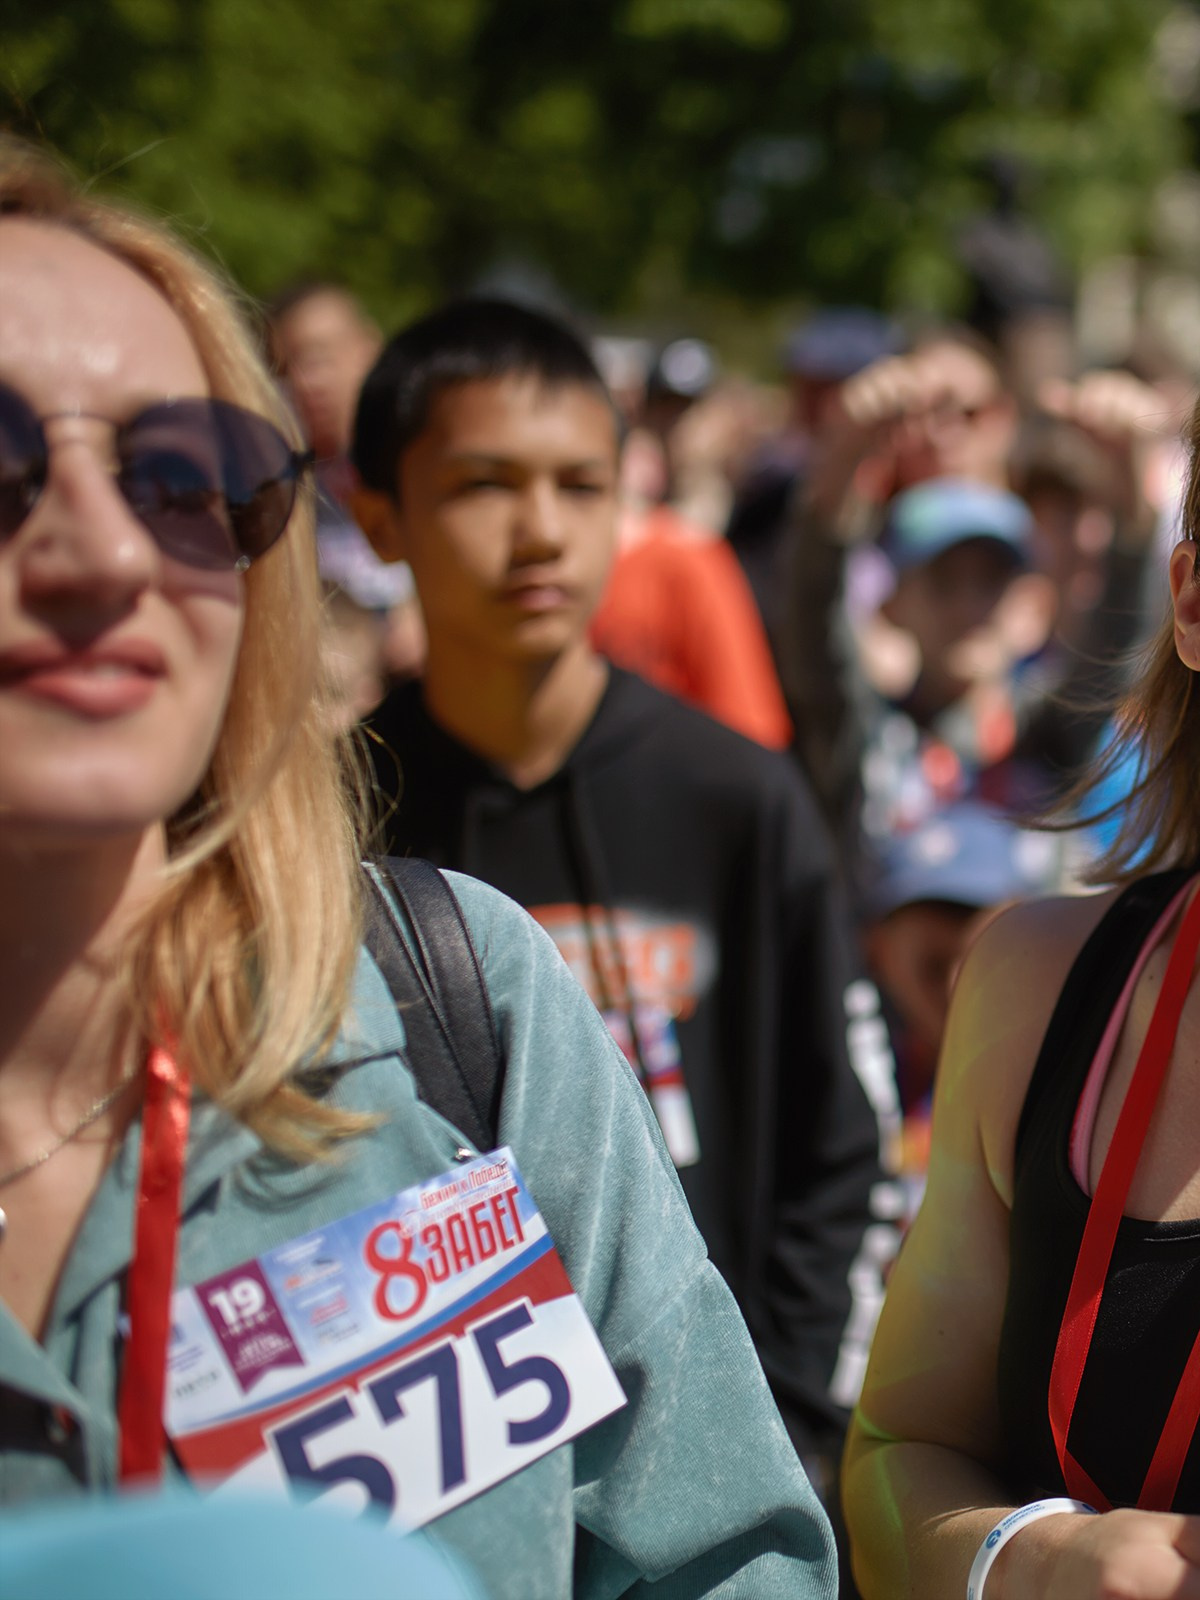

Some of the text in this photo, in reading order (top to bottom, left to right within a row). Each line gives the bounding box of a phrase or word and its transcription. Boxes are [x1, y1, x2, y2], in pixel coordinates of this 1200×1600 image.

[207, 1277, 266, 1324] 19
[362, 1221, 428, 1323] 8
[420, 1185, 525, 1285] ЗАБЕГ
[271, 1301, 571, 1526] 575
